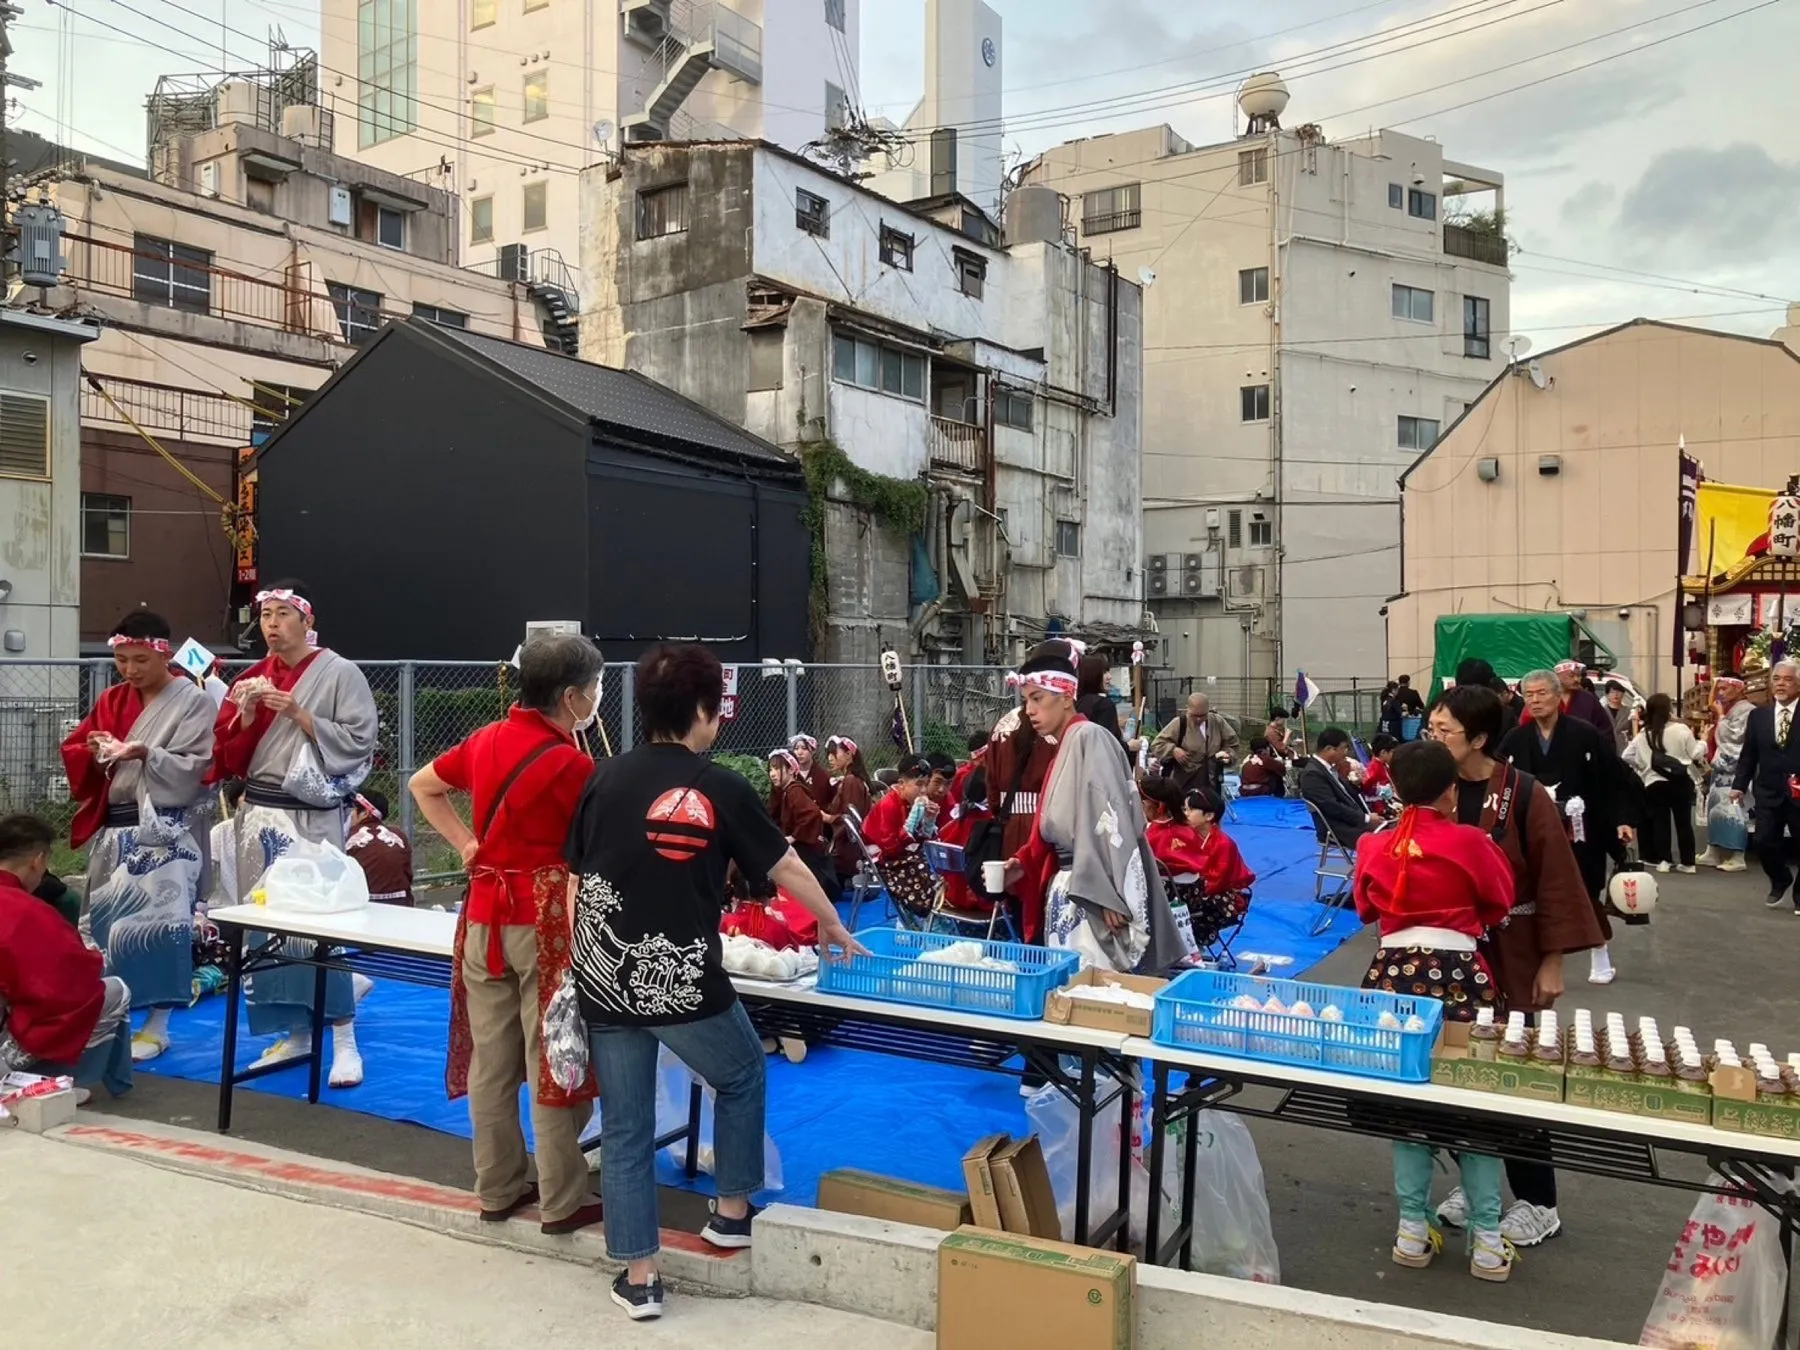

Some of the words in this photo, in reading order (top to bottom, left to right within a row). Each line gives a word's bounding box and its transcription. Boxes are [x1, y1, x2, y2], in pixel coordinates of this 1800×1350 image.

[1773, 499, 1797, 549] 八幡町
[187, 647, 205, 667] 八
